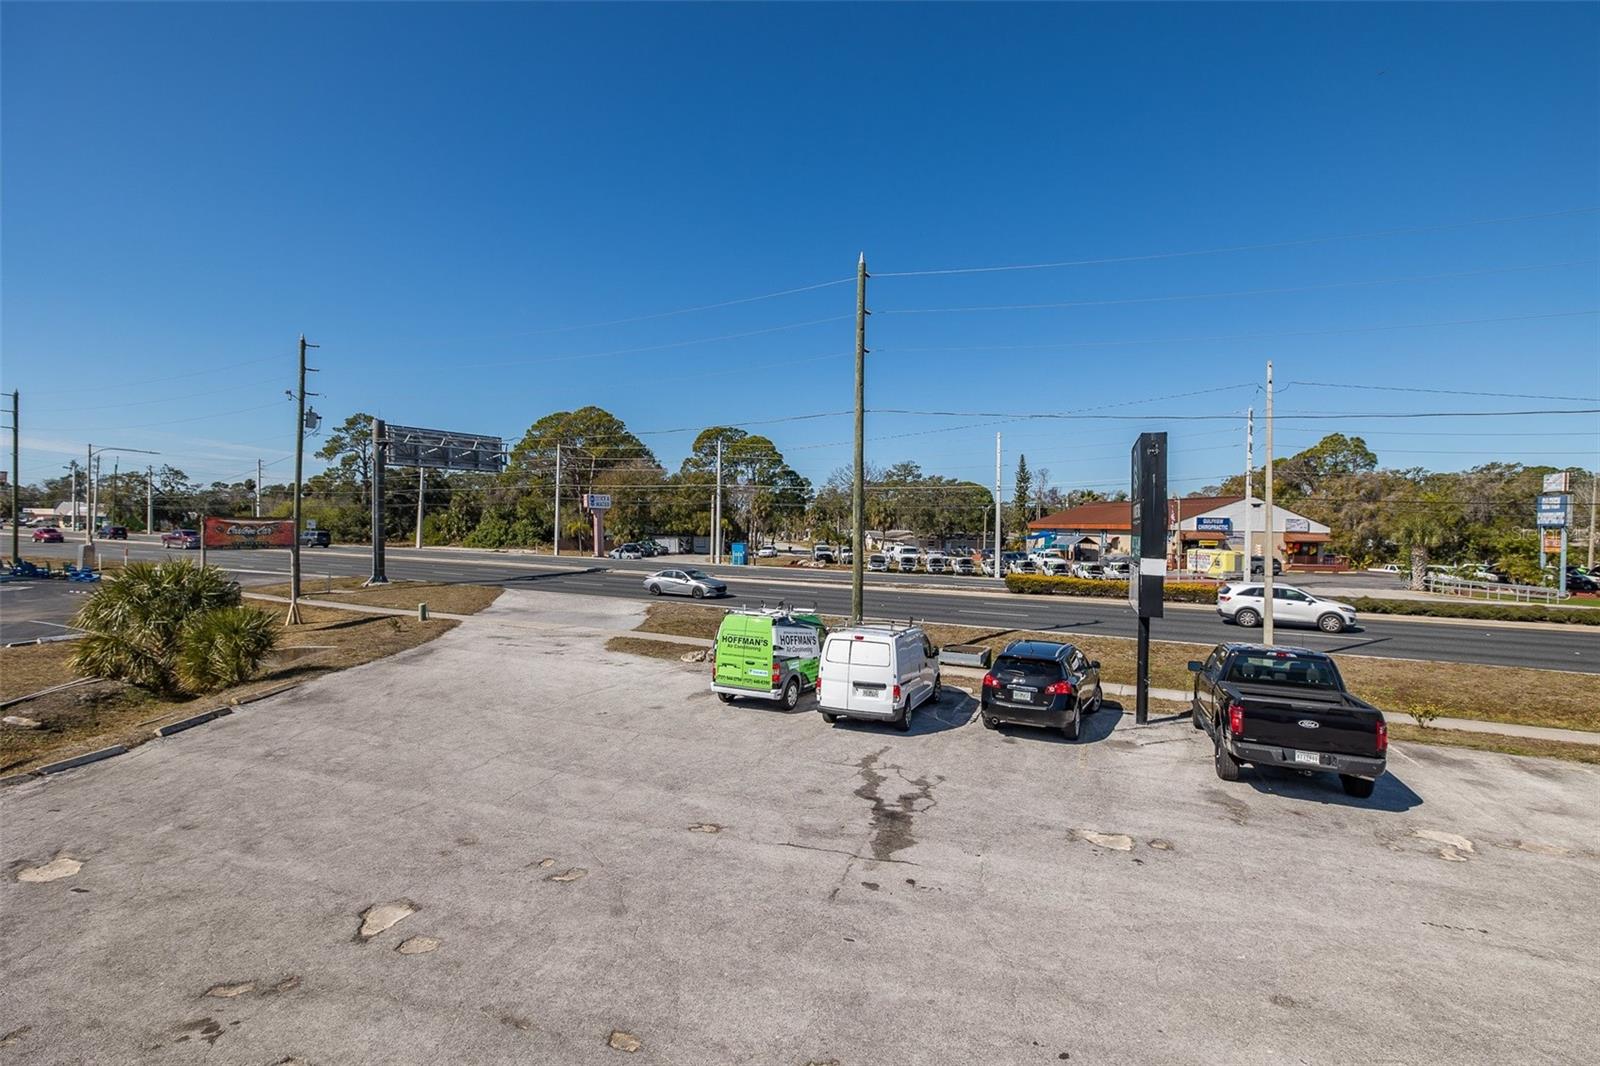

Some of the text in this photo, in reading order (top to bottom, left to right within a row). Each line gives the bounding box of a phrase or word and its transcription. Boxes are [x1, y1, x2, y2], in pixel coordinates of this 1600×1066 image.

[722, 635, 769, 647] HOFFMAN'S
[780, 634, 817, 646] HOFFMAN'S
[734, 644, 761, 652] Conditioning
